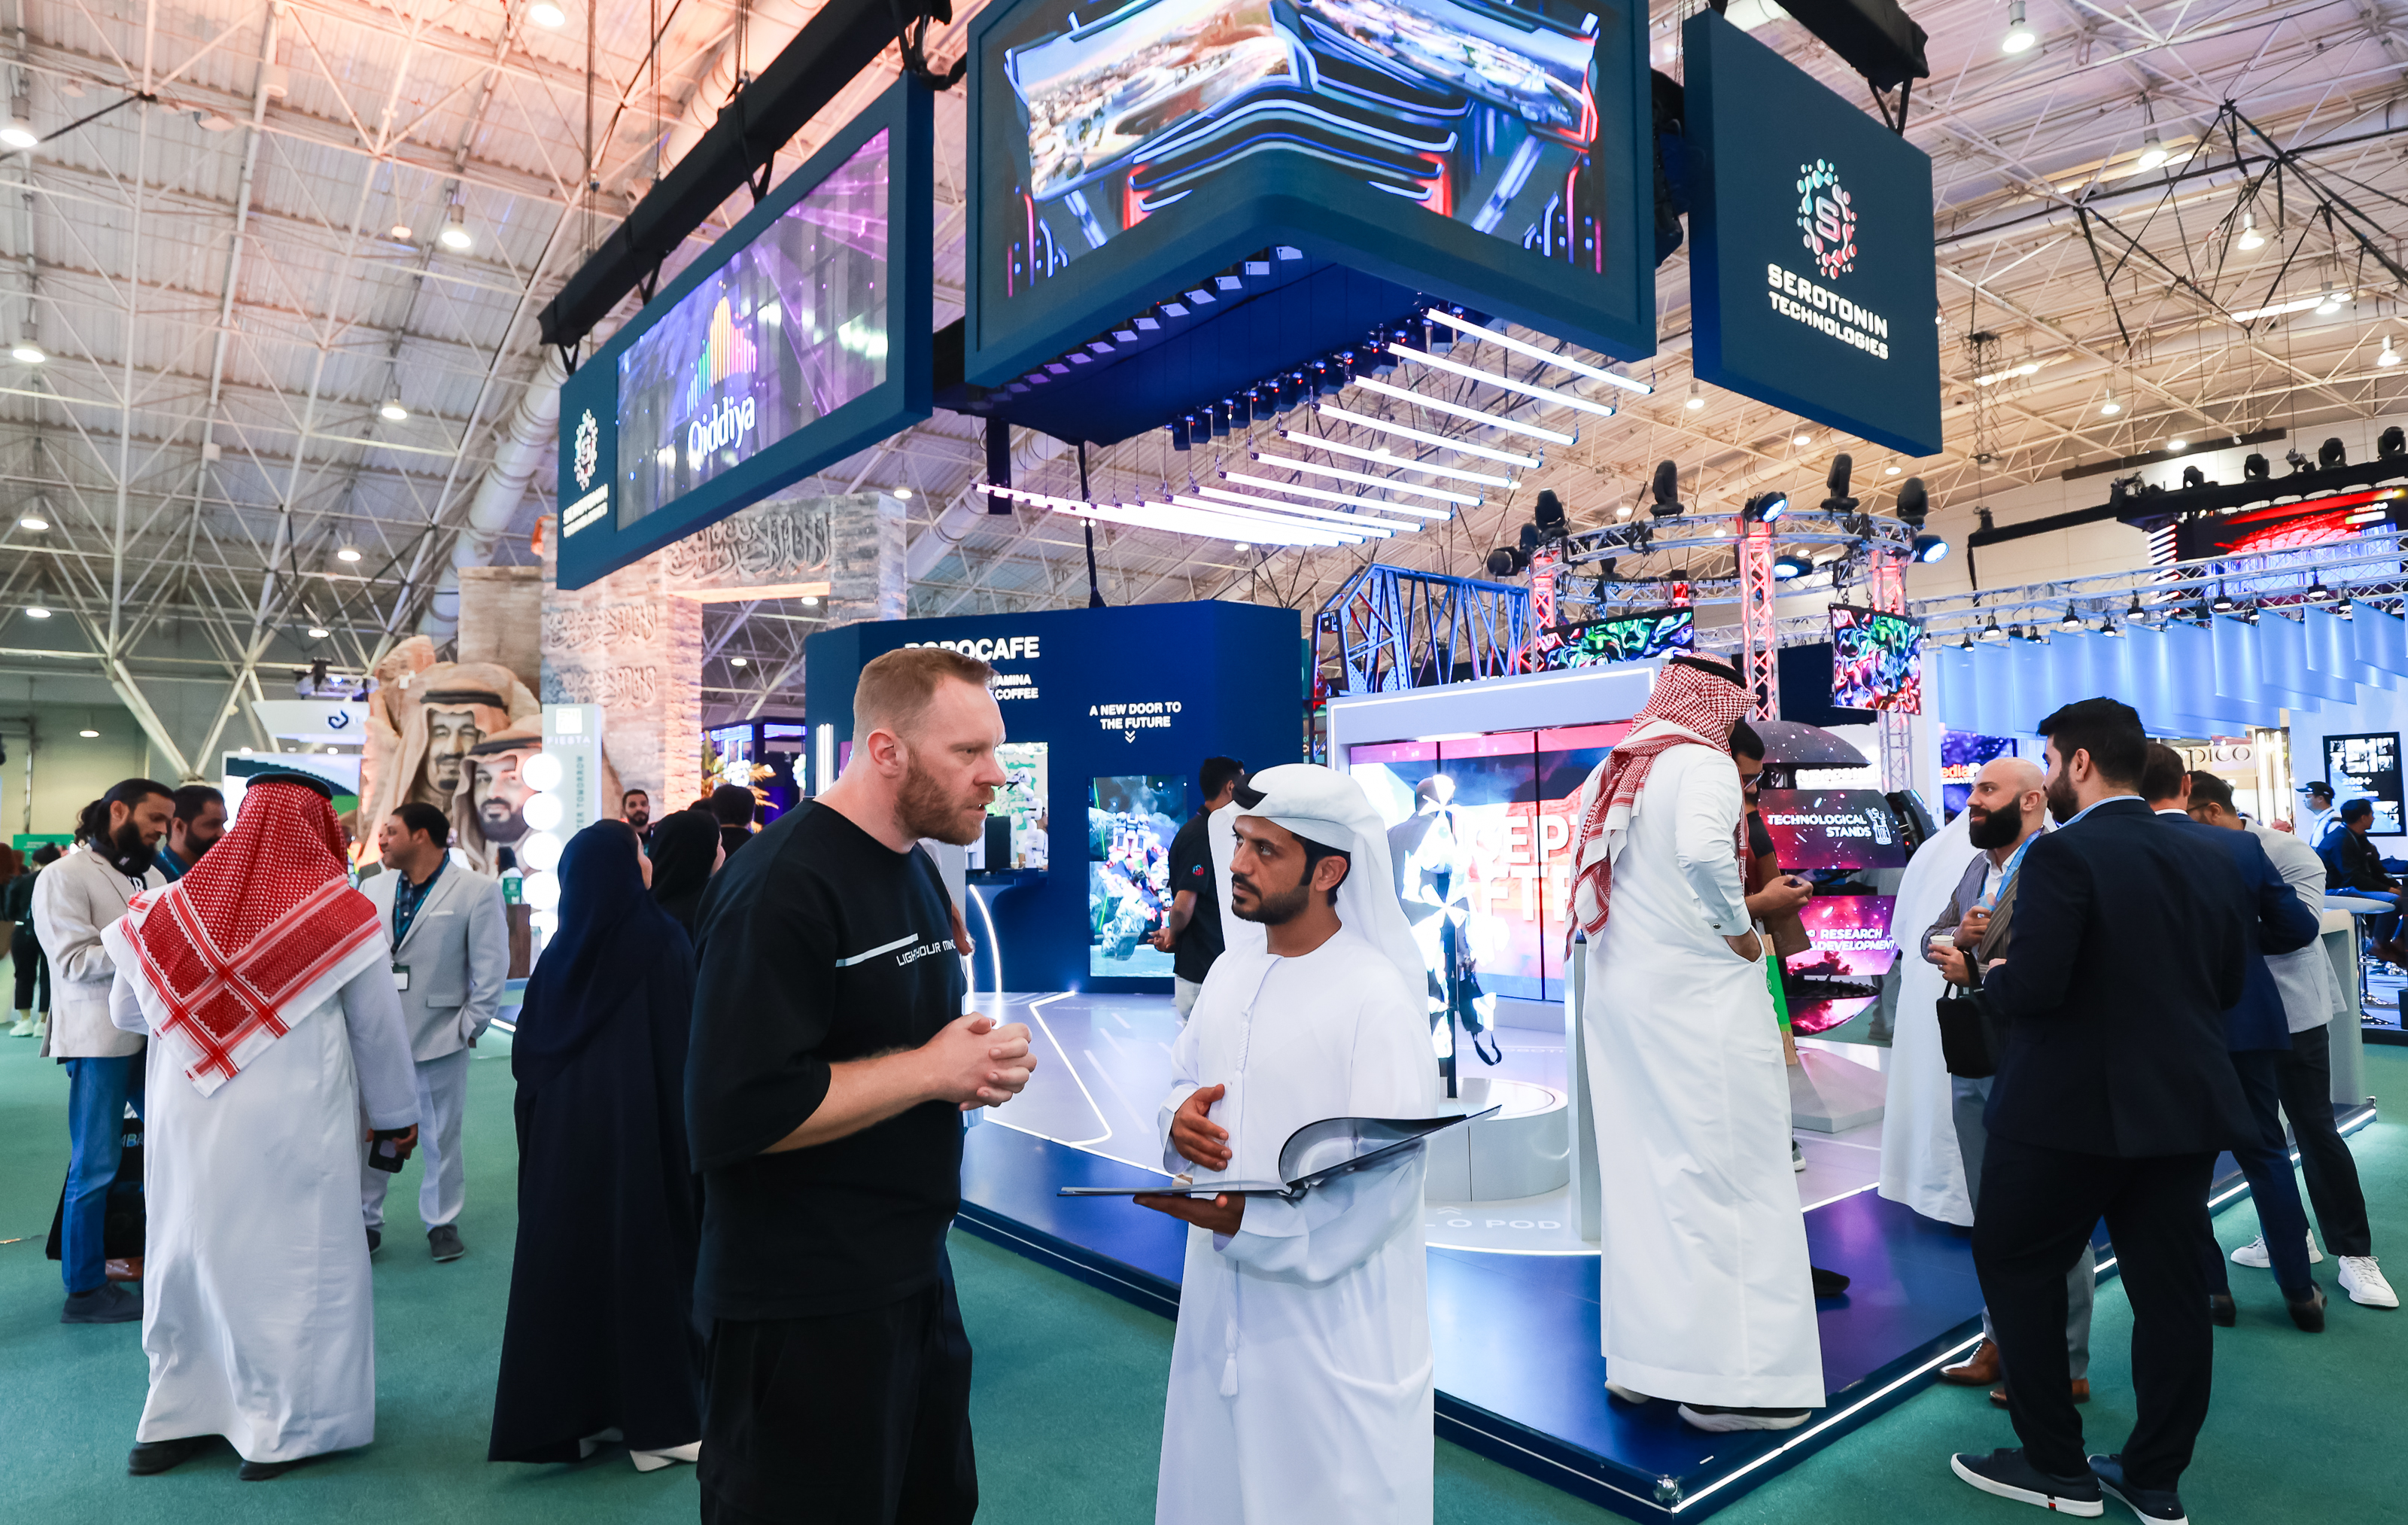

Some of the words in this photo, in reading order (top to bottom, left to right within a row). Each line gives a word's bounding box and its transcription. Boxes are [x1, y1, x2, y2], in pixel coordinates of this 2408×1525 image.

[1767, 263, 1889, 339] SEROTONIN
[1768, 291, 1890, 360] TECHNOLOGIES
[687, 396, 756, 472] Qiddiya
[994, 687, 1039, 701] COFFEE
[1089, 705, 1099, 717] A
[1100, 704, 1127, 717] NEW
[1129, 702, 1163, 715] DOOR
[1165, 701, 1182, 713] TO
[1099, 718, 1123, 730] THE
[1125, 716, 1172, 729] FUTURE
[546, 735, 591, 746] FIESTA
[1940, 762, 1981, 778] ediaP
[576, 756, 585, 808] TOMORROW
[2342, 776, 2373, 786] 200+
[1767, 814, 1868, 826] TECHNOLOGICAL
[1826, 826, 1872, 838] STANDS
[1820, 928, 1884, 940] RESEARCH
[1485, 1219, 1562, 1230] POD
